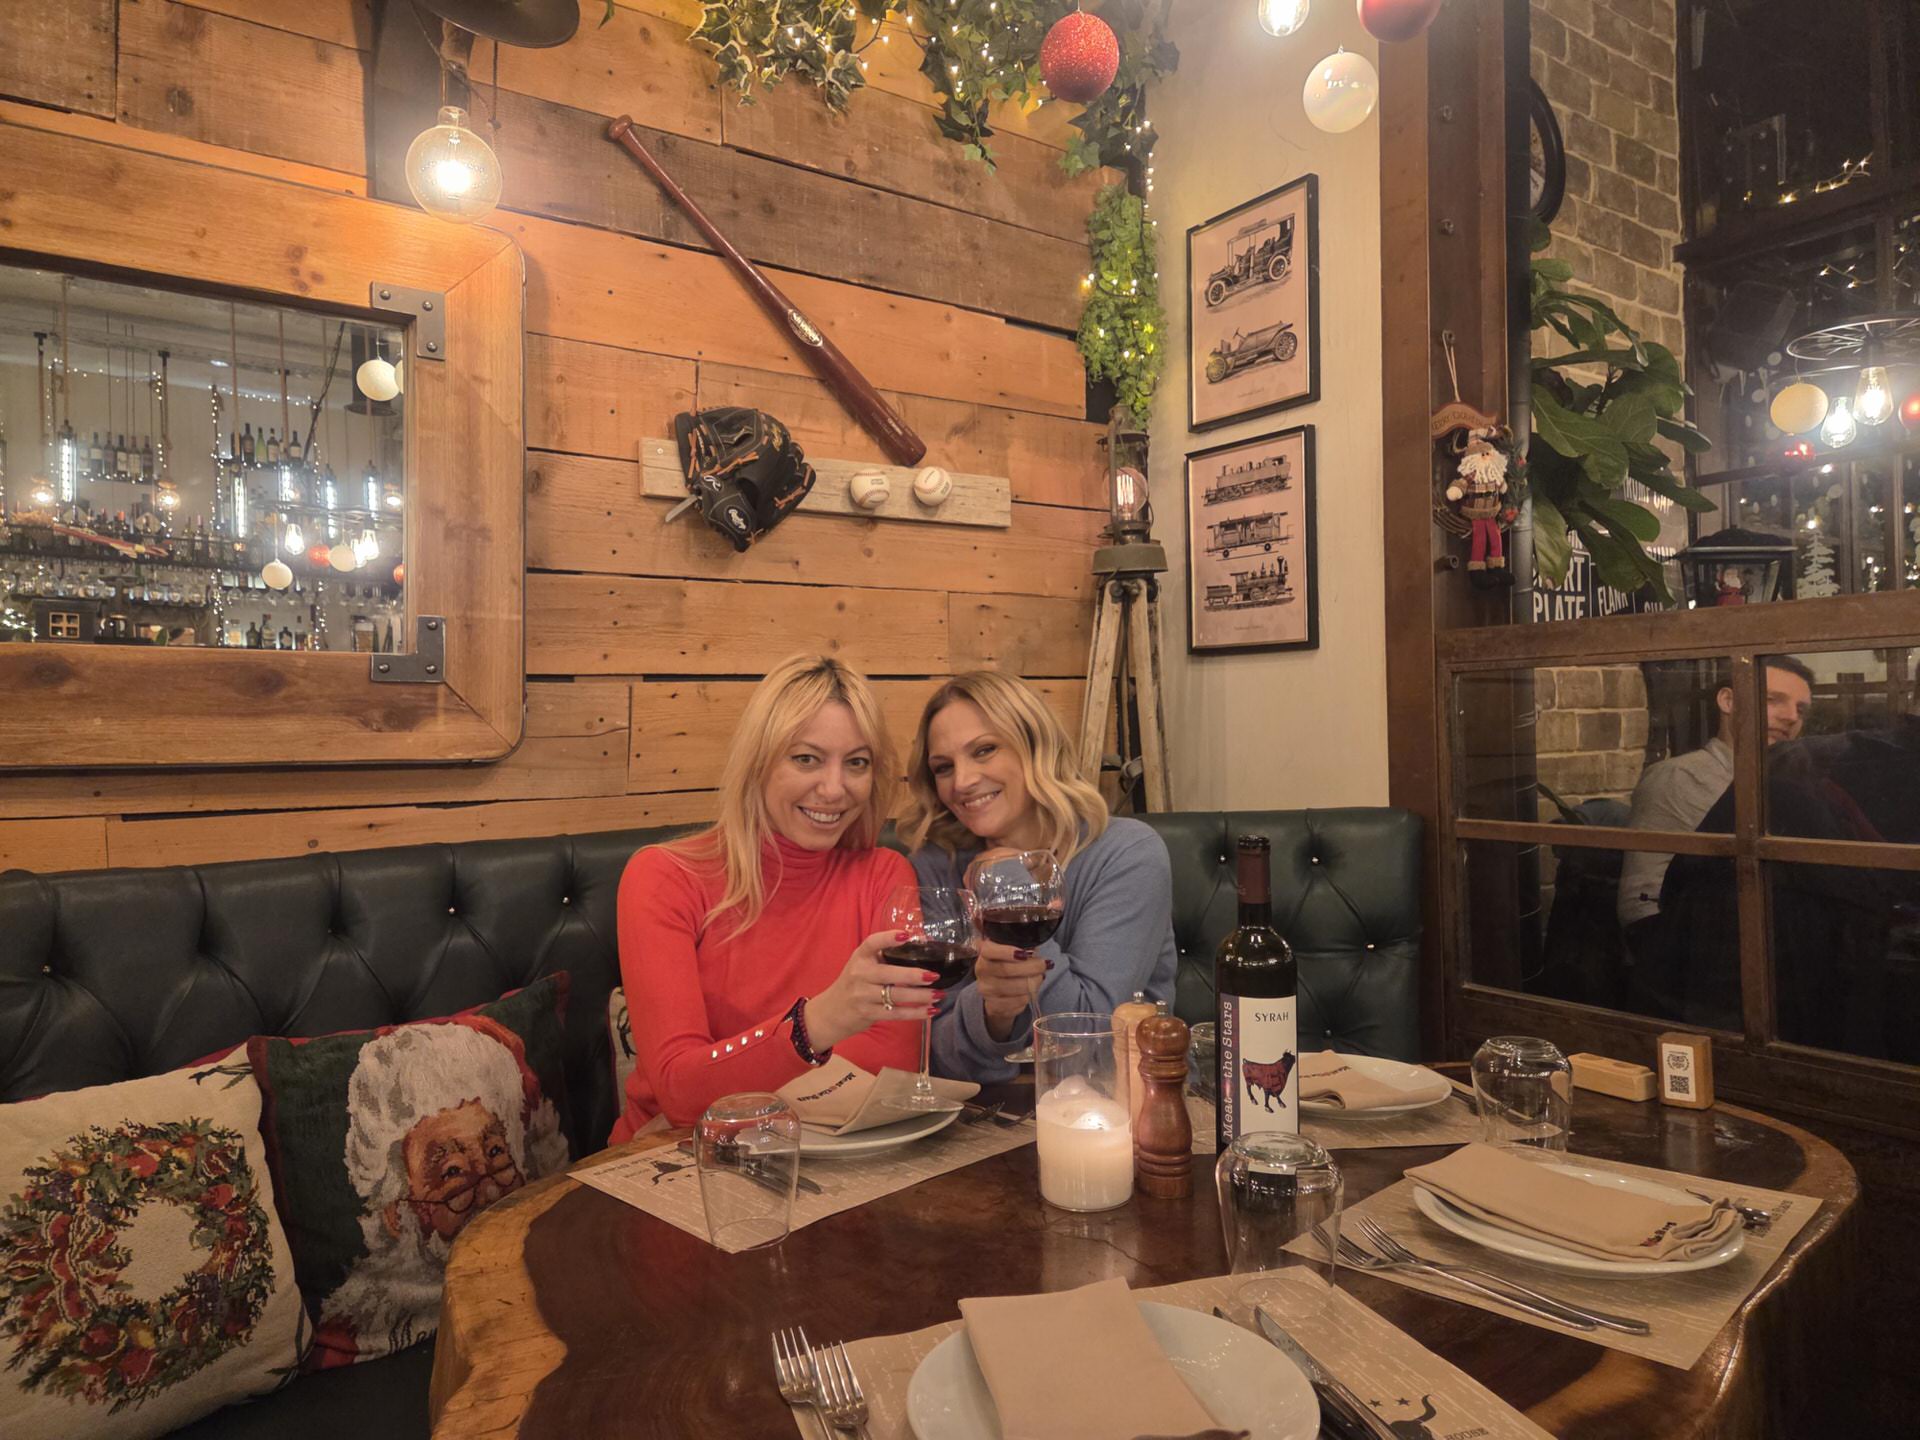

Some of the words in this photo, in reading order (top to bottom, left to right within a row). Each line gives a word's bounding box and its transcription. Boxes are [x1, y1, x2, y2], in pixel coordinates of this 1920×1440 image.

[1222, 1001, 1233, 1048] Stars
[1254, 1011, 1290, 1023] SYRAH
[1222, 1050, 1233, 1078] the
[1222, 1098, 1233, 1140] Meat
